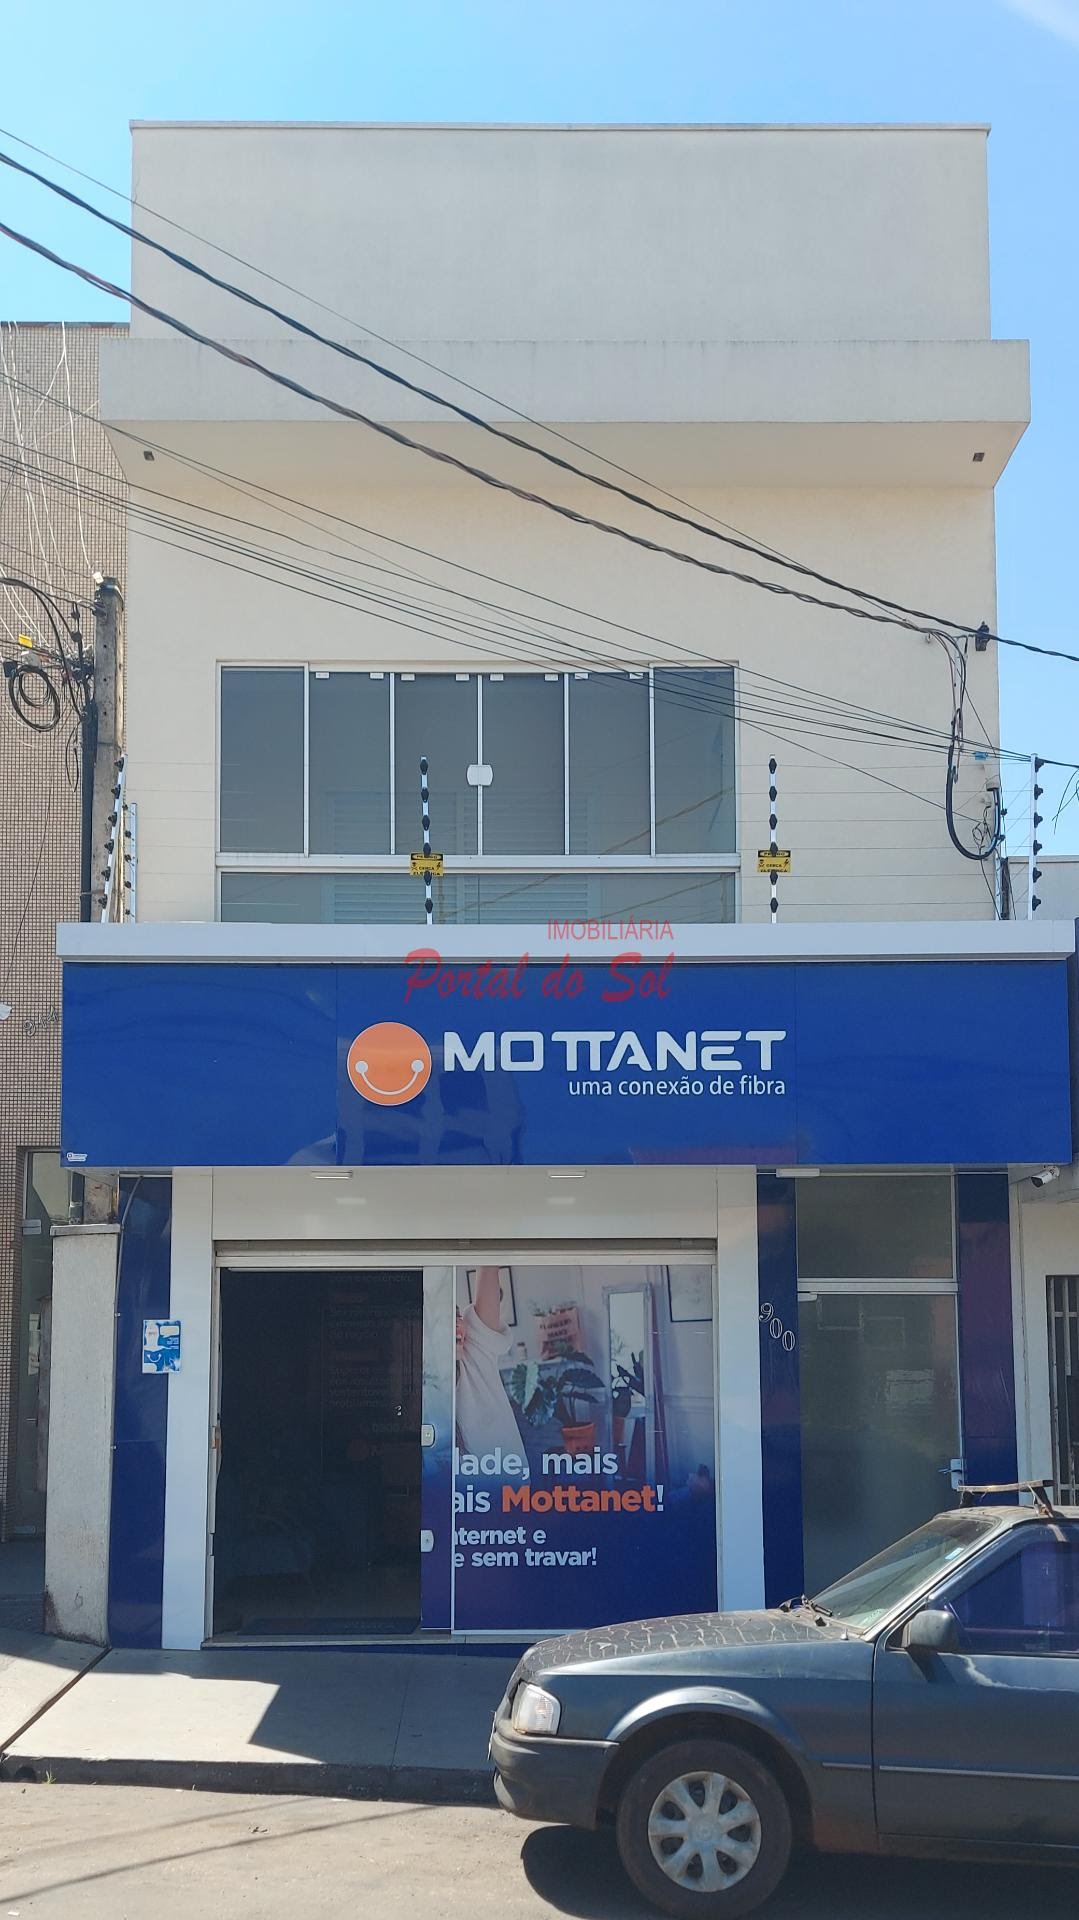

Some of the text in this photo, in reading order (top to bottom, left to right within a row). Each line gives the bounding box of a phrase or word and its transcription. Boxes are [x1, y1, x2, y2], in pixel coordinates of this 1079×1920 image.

[443, 1030, 787, 1072] MOTTANET
[568, 1075, 786, 1096] uma conexão de fibra
[758, 1302, 796, 1351] 900
[542, 1446, 618, 1475] mais
[502, 1484, 664, 1513] Mottanet!
[533, 1530, 547, 1545] e
[471, 1551, 519, 1568] sem
[525, 1547, 597, 1567] travar!
